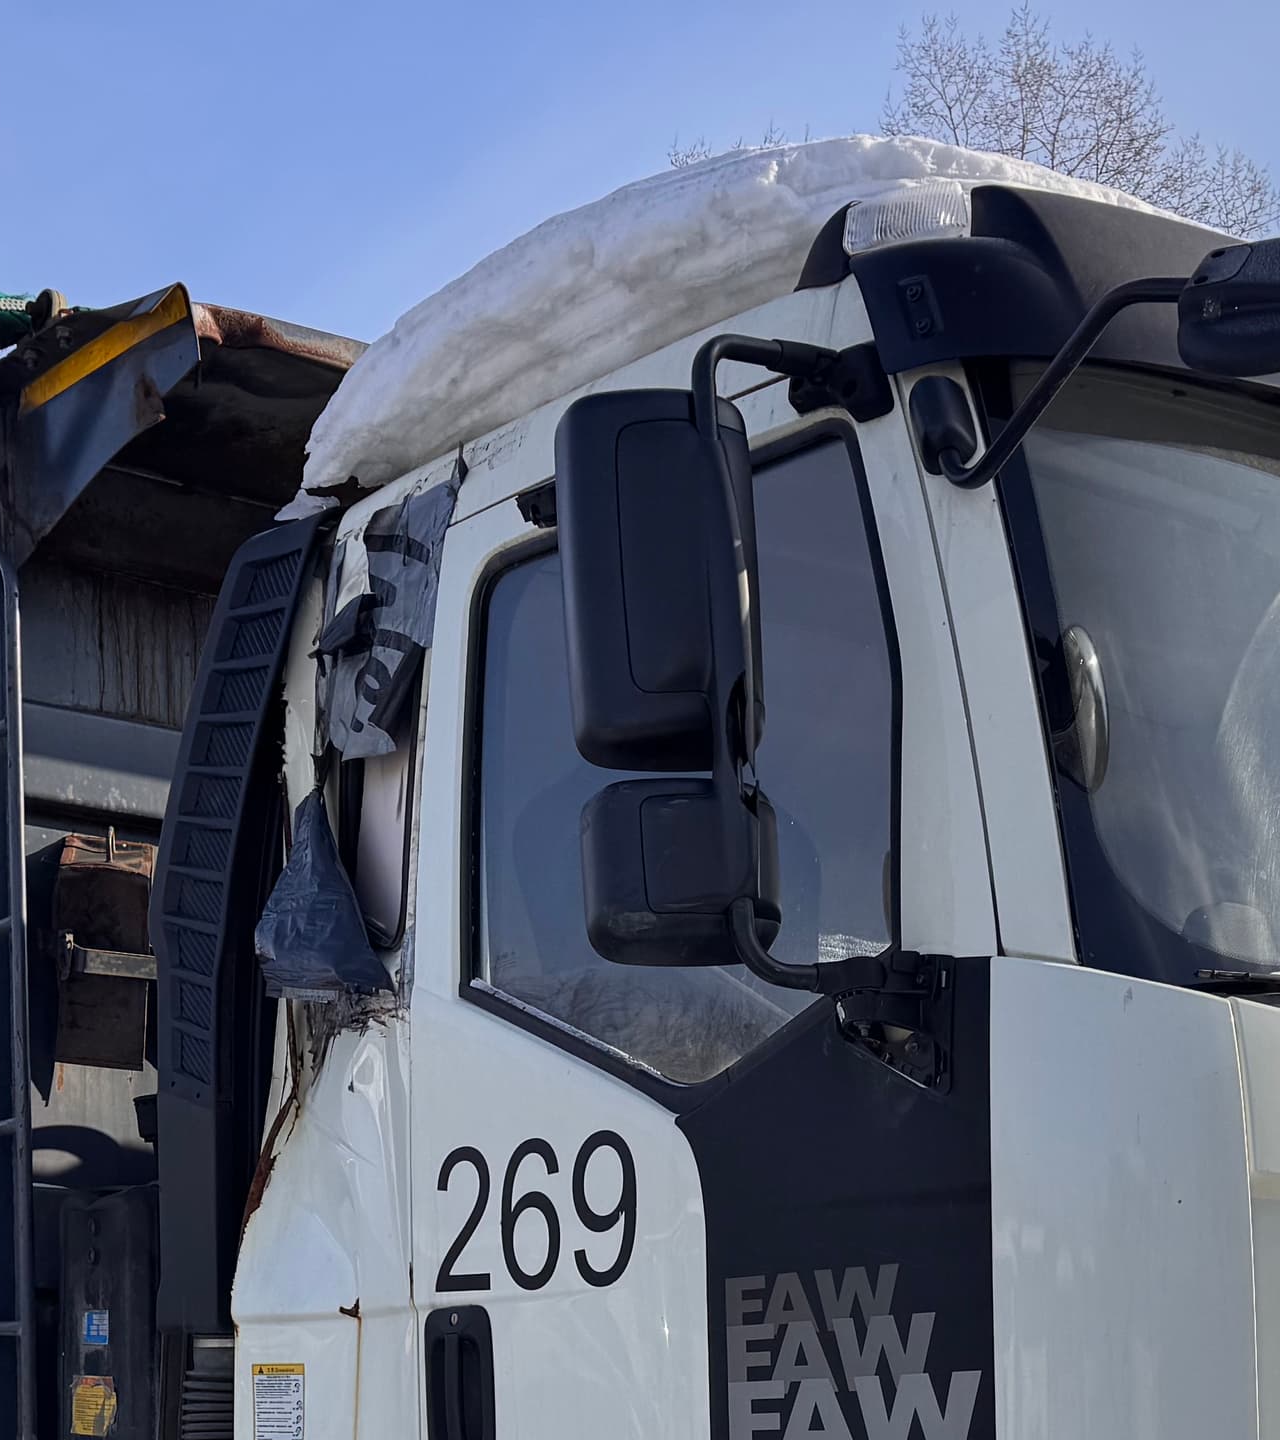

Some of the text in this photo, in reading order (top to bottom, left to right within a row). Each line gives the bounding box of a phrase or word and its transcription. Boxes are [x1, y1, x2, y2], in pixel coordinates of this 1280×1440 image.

[435, 1129, 637, 1292] 269
[725, 1263, 899, 1332] FAW
[727, 1312, 936, 1393] FAW
